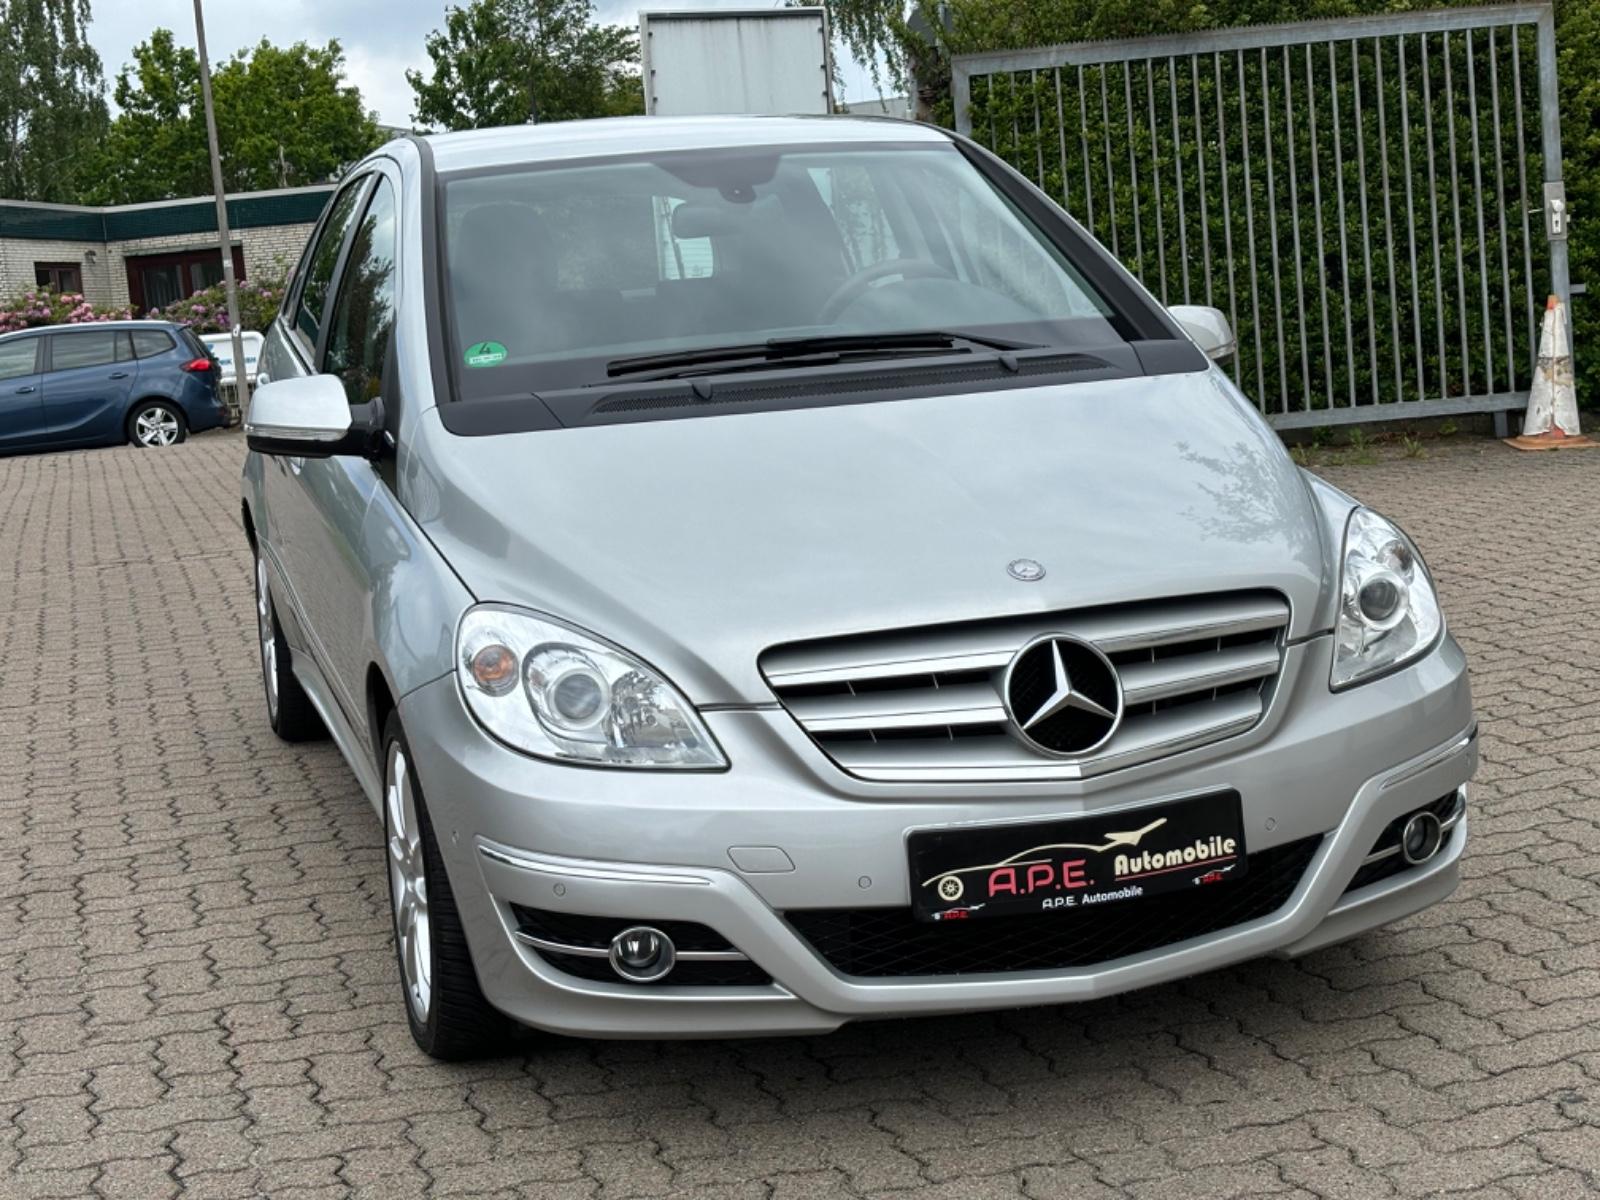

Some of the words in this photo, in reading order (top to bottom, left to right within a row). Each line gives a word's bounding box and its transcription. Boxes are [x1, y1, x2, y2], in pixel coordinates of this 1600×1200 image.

[479, 342, 491, 354] 4
[988, 859, 1096, 897] A.P.E.
[1114, 836, 1237, 876] Automobile
[1081, 885, 1143, 904] Automobile
